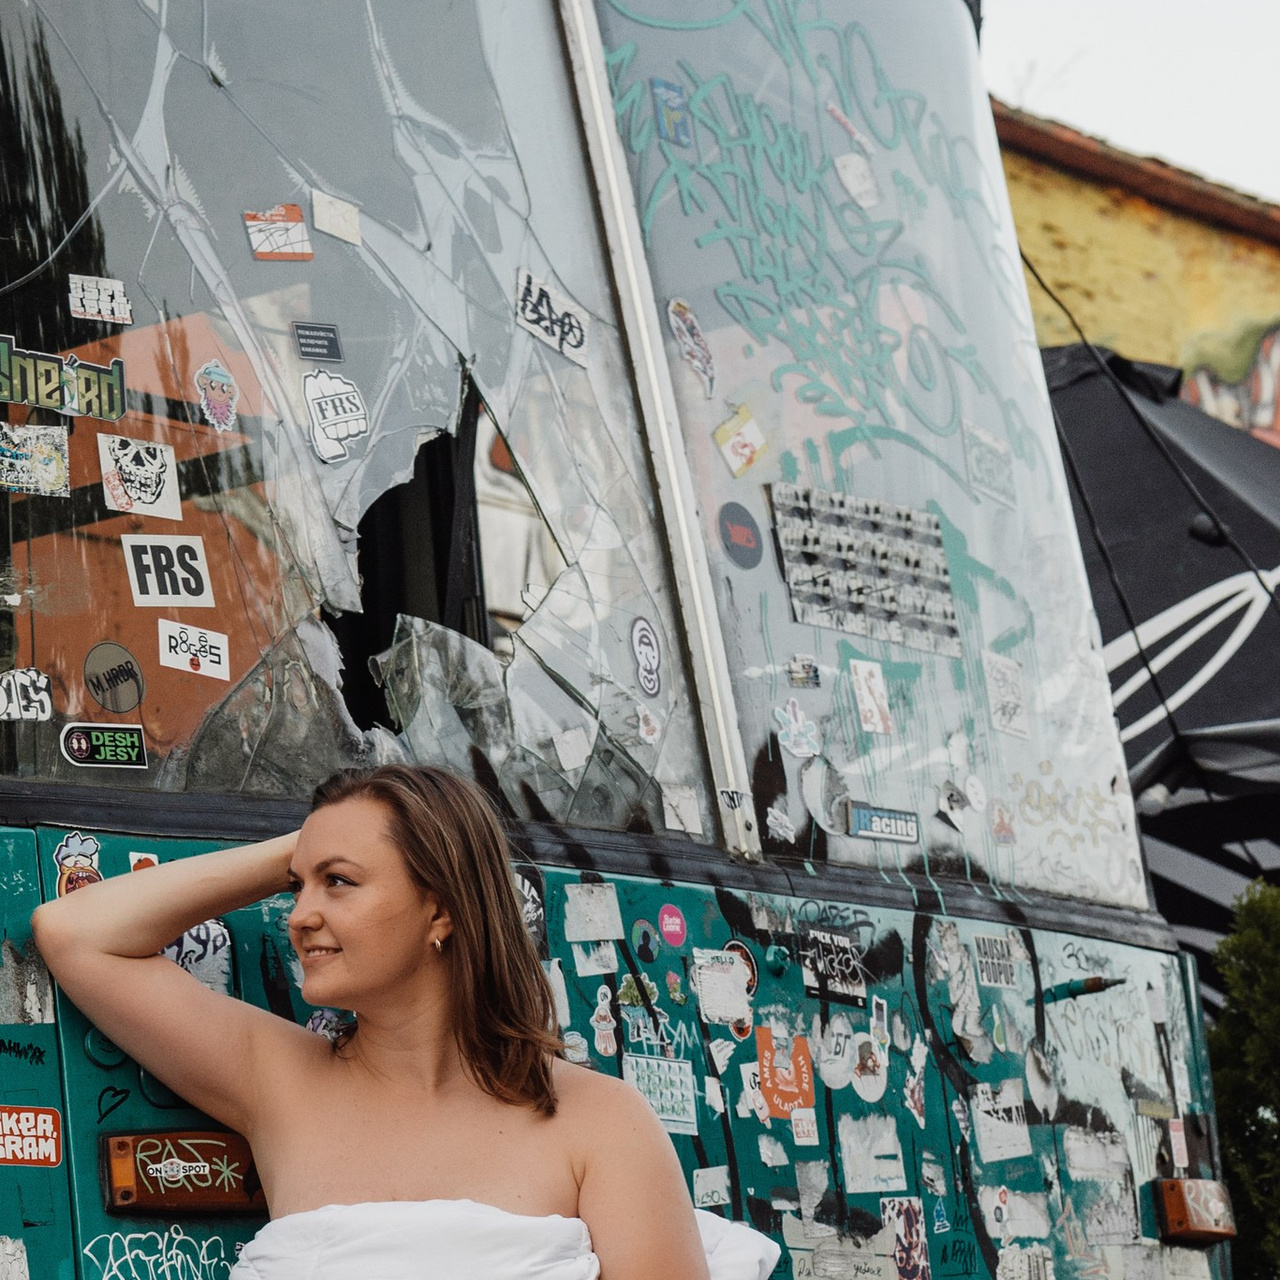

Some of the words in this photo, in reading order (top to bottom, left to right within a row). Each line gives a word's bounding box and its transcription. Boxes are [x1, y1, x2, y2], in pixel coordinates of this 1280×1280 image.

[315, 394, 360, 421] FRS
[130, 544, 205, 598] FRS
[91, 731, 140, 747] DESH
[95, 746, 140, 761] JESY
[831, 934, 850, 949] YOU
[147, 1167, 163, 1176] ON
[181, 1165, 207, 1175] SPOT
